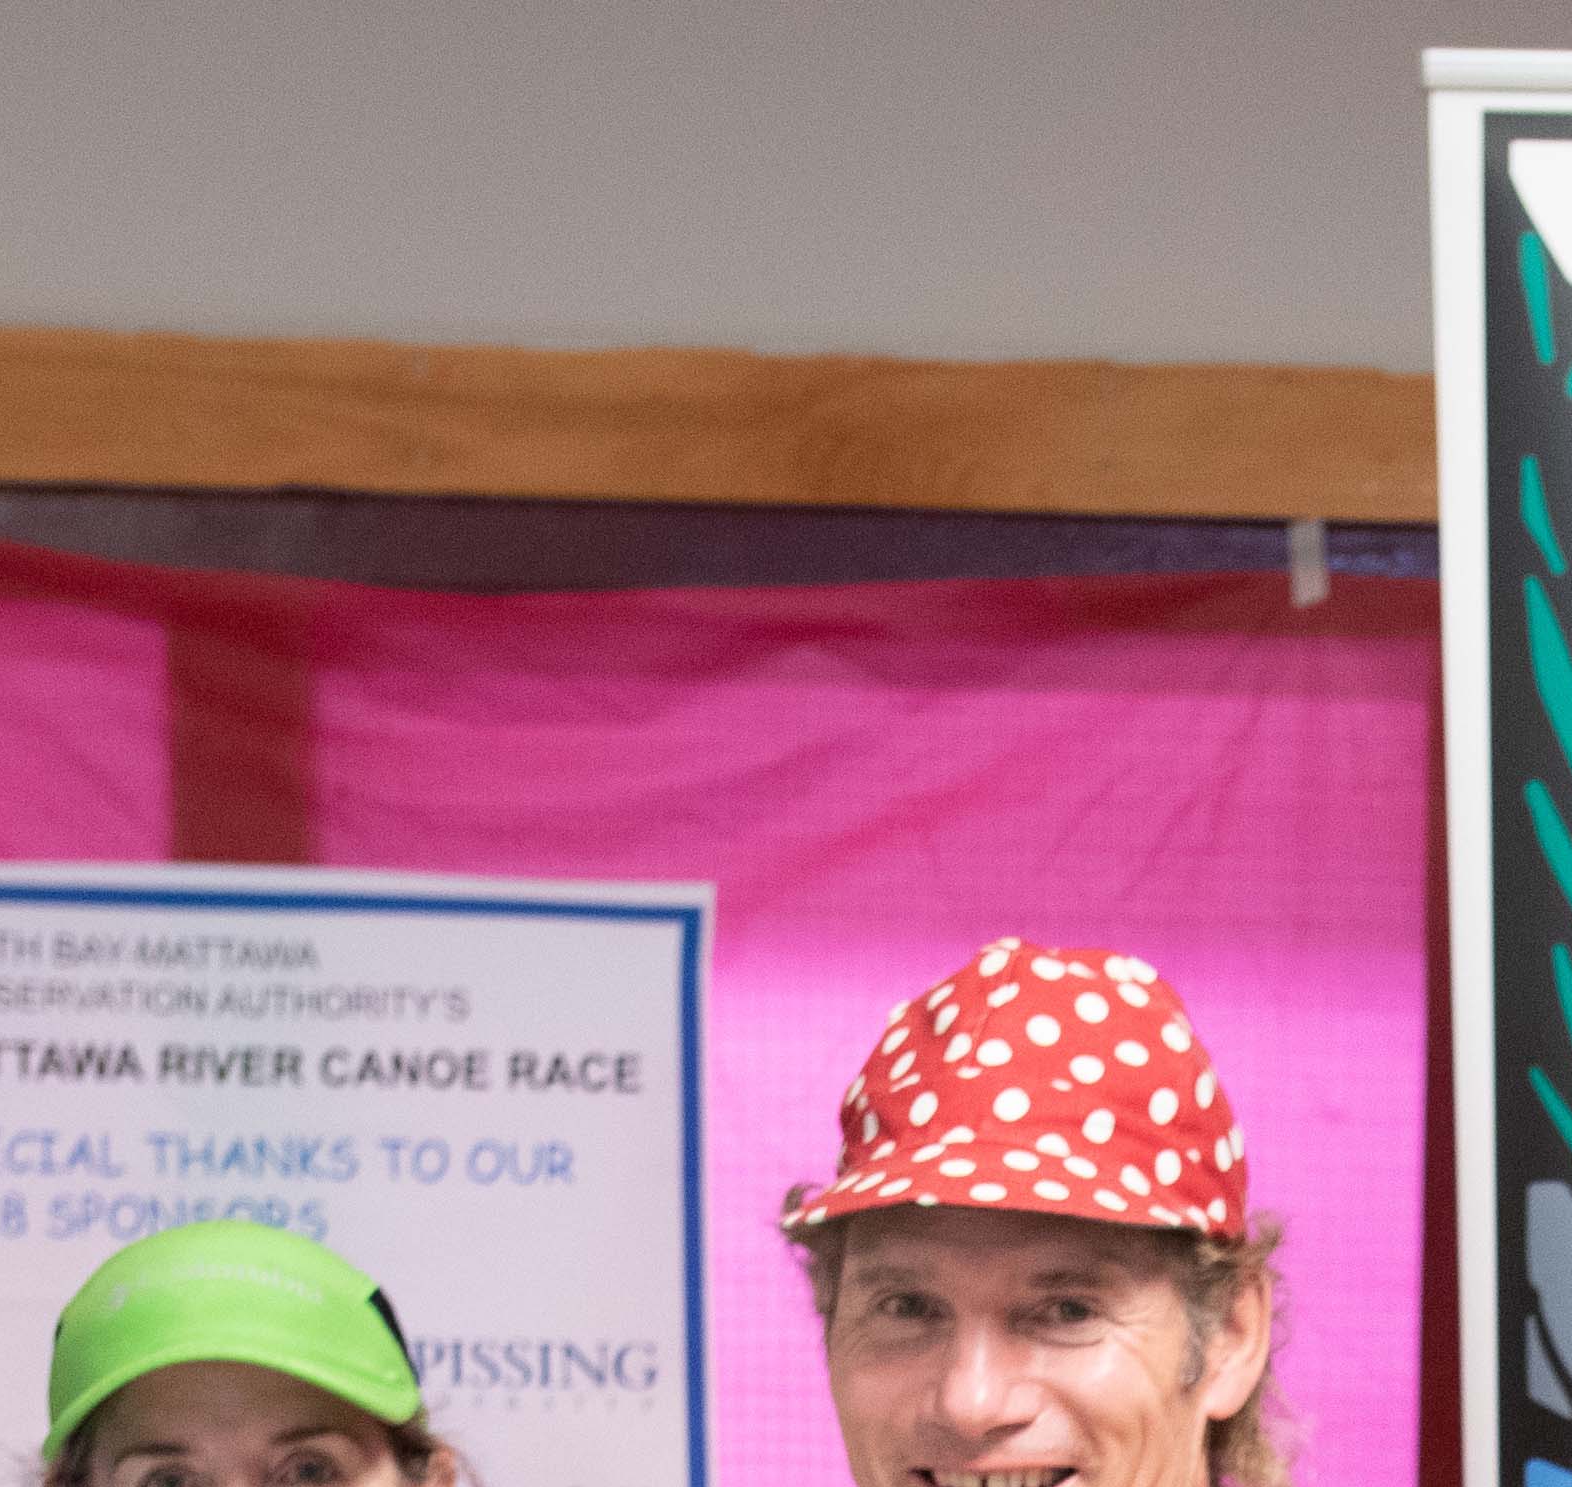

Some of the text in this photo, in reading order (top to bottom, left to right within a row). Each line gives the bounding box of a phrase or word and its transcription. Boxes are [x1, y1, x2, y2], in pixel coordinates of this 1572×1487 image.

[159, 1042, 302, 1088] RIVER
[318, 1045, 490, 1093] CANOE
[508, 1049, 642, 1095] RACE
[145, 1129, 358, 1182] THANKS
[387, 1137, 449, 1182] TO
[466, 1140, 575, 1186] OUR
